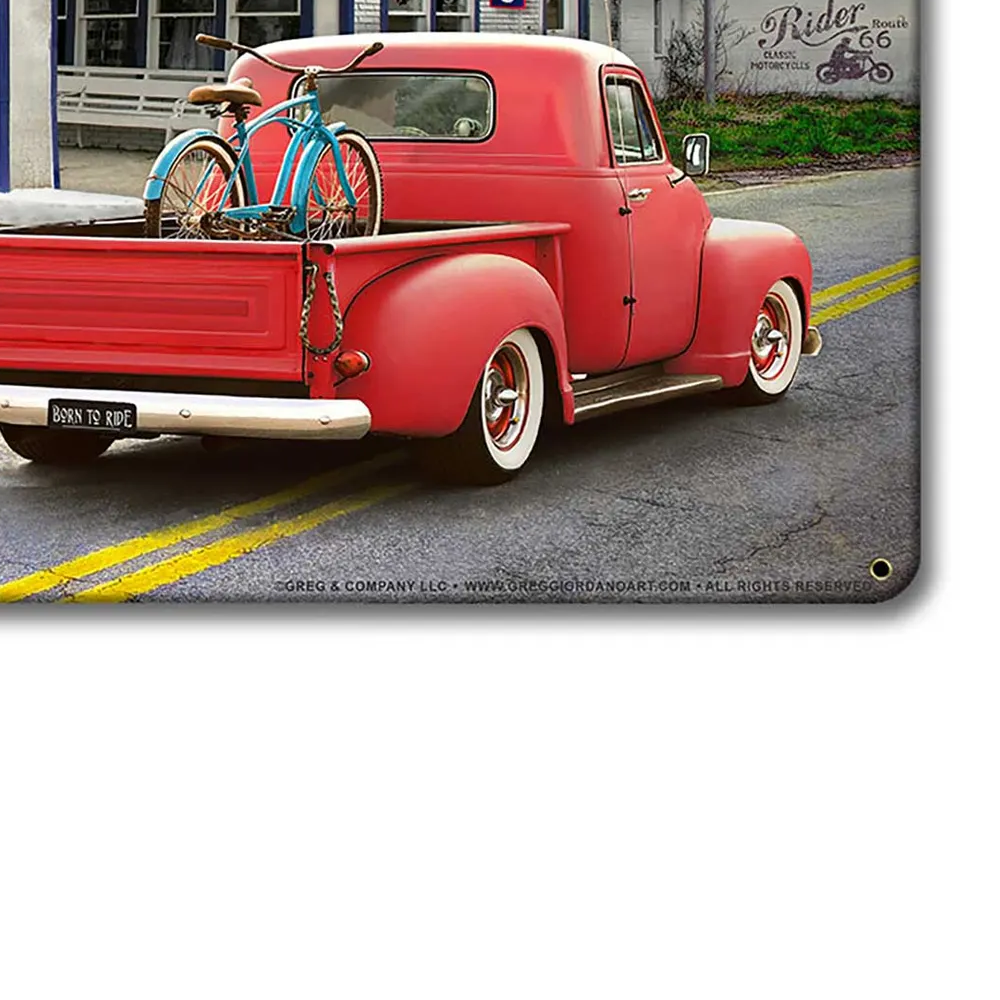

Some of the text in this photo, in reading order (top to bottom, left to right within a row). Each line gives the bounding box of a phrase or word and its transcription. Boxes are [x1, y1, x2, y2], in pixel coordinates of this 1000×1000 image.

[871, 15, 910, 29] Route
[858, 29, 893, 49] 66
[51, 404, 133, 429] BORN TO RIDE
